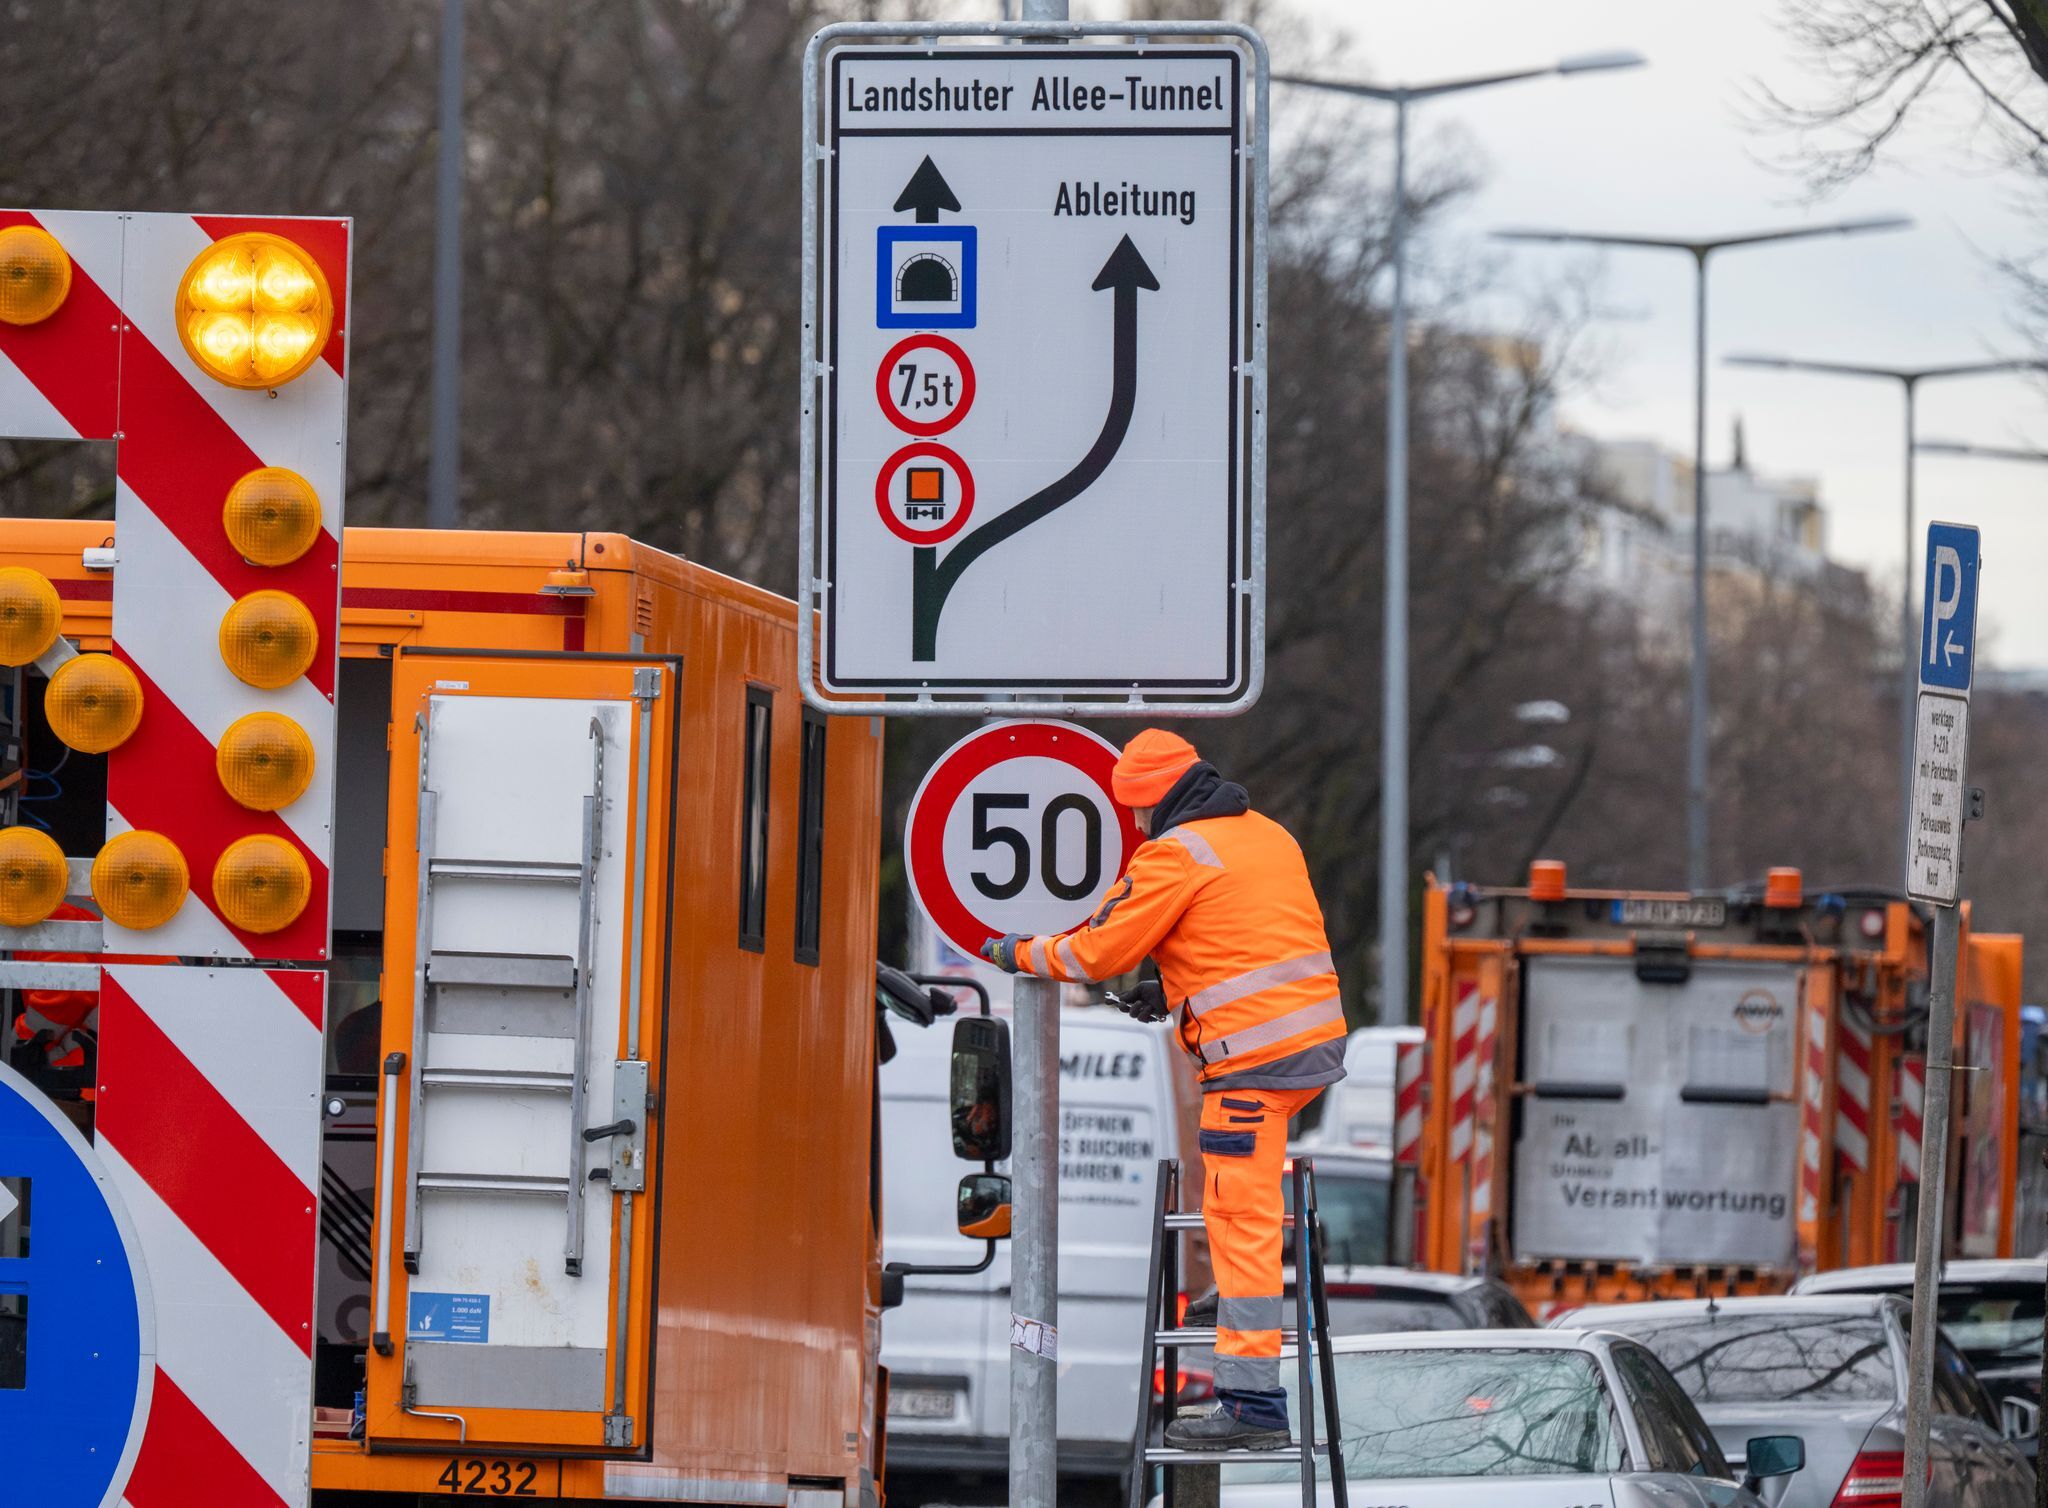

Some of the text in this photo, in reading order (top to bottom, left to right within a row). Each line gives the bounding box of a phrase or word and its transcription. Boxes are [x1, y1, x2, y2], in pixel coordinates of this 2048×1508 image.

[847, 76, 1224, 112] Landshuter Allee-Tunnel
[1054, 181, 1196, 225] Ableitung
[1929, 546, 1962, 664] P
[1931, 710, 1954, 732] werktags
[1920, 760, 1958, 782] mit Parkschein
[1931, 787, 1943, 806] oder
[1920, 812, 1952, 835] Parkausweis
[970, 793, 1102, 901] 50
[1918, 838, 1951, 864] Rotkreuzplatz
[1926, 867, 1939, 887] Nord
[1059, 1052, 1145, 1080] MILES
[1560, 1182, 1787, 1219] Verantwortung
[438, 1460, 538, 1496] 4232
